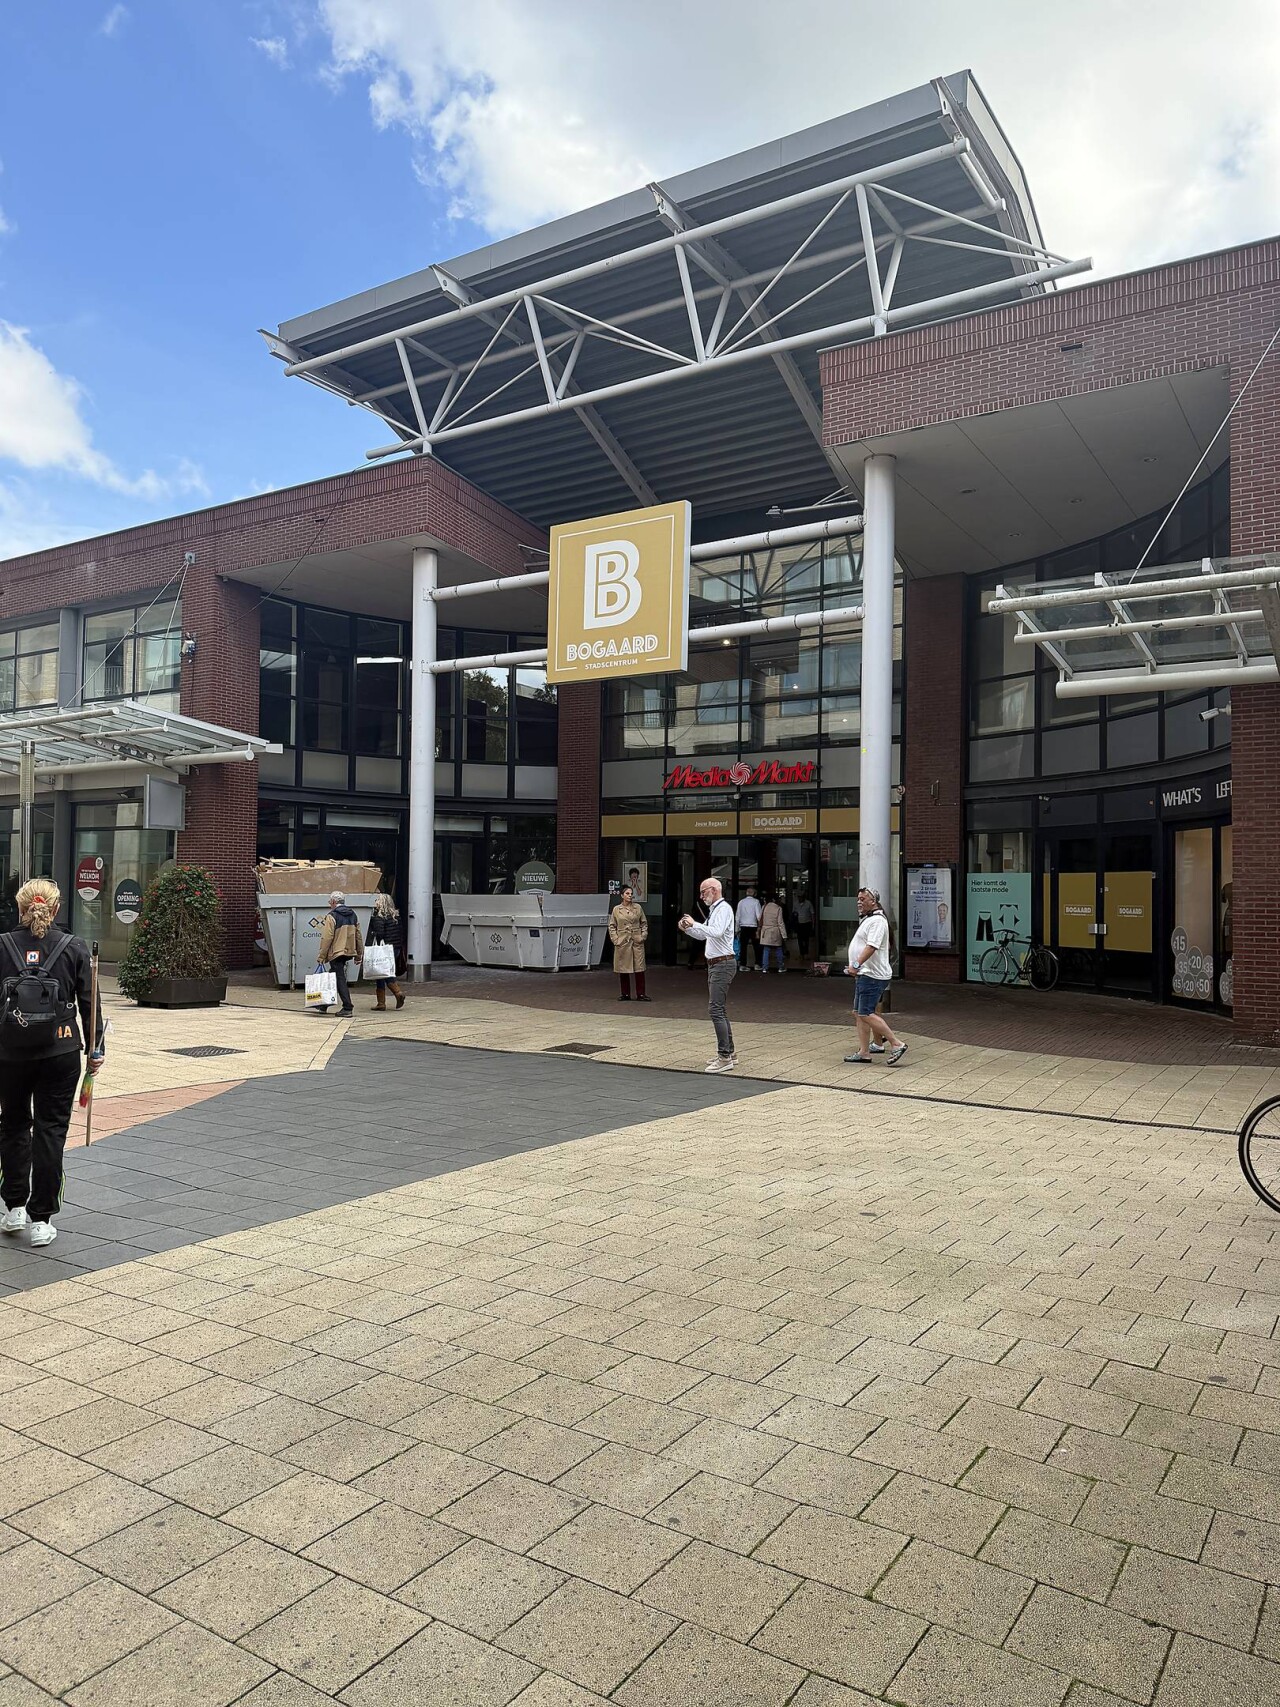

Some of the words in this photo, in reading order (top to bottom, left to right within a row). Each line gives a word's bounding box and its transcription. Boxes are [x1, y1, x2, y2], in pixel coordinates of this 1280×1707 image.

[584, 540, 642, 630] B
[567, 634, 658, 661] BOGAARD
[585, 658, 638, 670] STADSCENTRUM
[662, 765, 731, 789] Media
[747, 760, 815, 785] Markt
[1162, 787, 1202, 807] WHAT'S
[754, 816, 803, 827] BOGAARD
